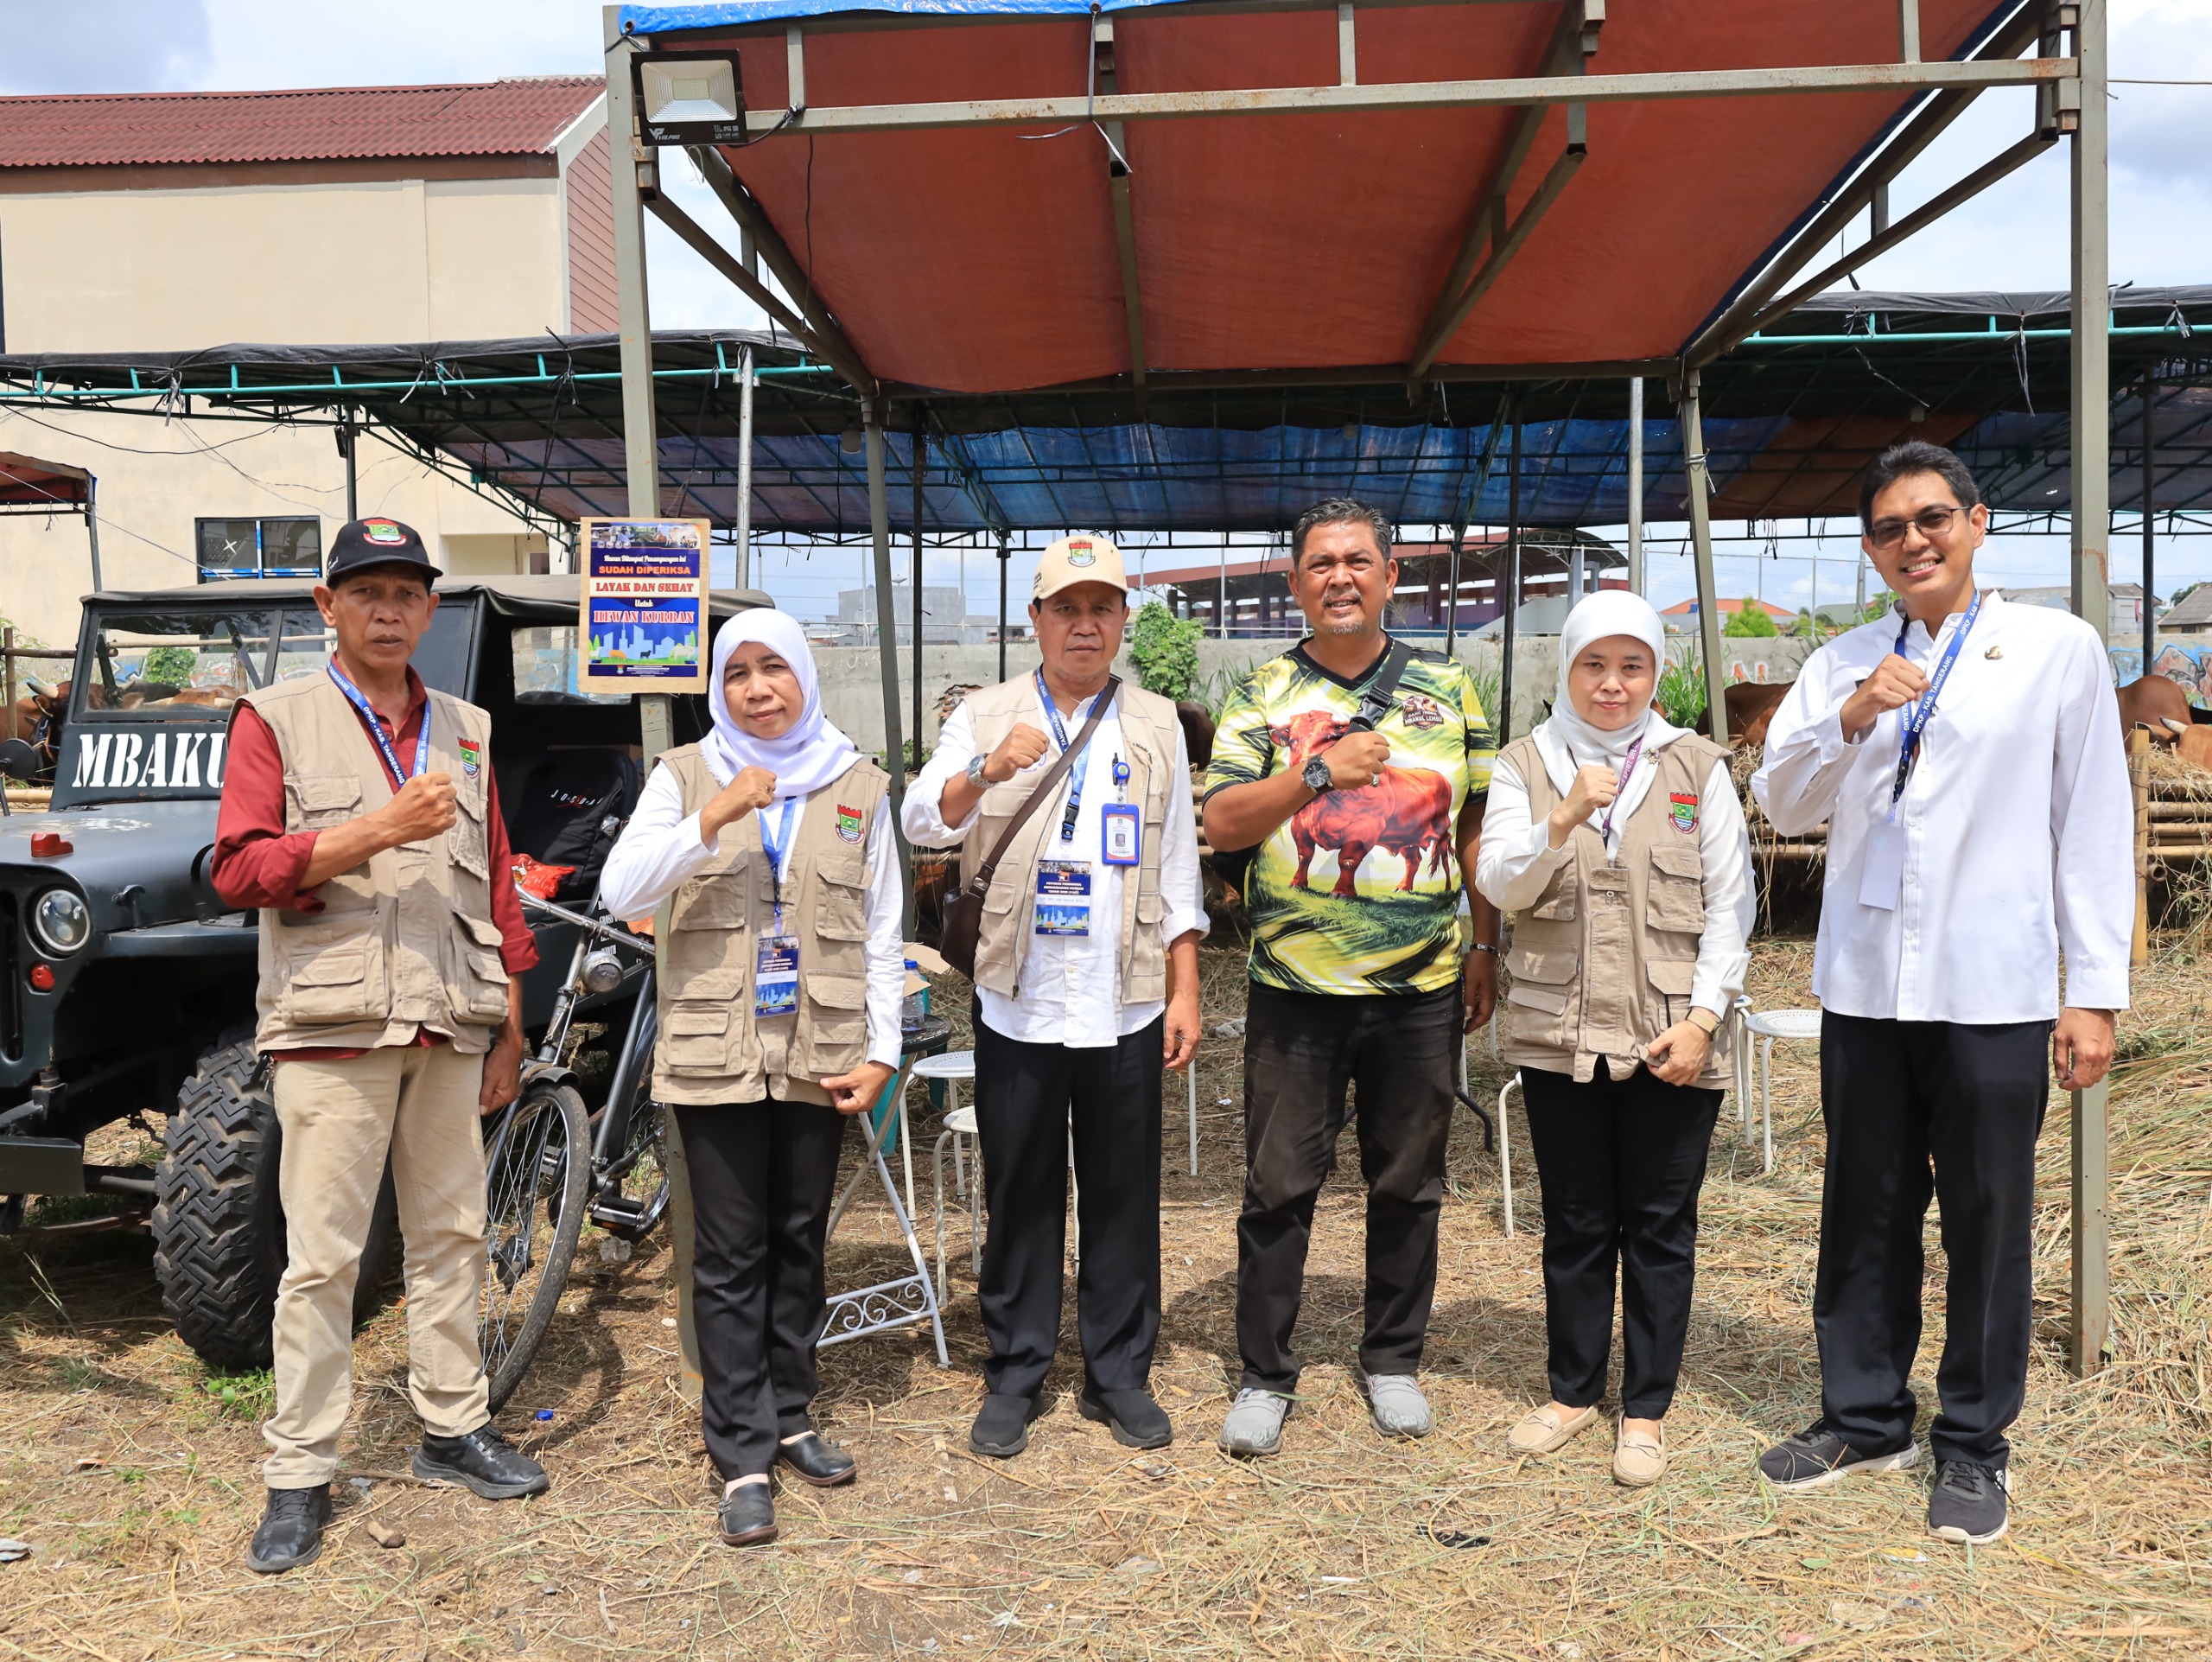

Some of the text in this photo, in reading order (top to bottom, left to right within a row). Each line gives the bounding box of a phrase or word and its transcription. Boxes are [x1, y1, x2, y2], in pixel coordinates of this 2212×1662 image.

[636, 566, 691, 575] DIPERIKSA
[596, 583, 631, 591] LAYAK
[658, 583, 694, 592] SEHAT
[594, 610, 695, 623] HEWAN KURBAN
[1960, 619, 1970, 635] DPKP
[1912, 714, 1924, 733] DPKP
[1922, 694, 1935, 710] KAB.
[1929, 655, 1953, 694] TANGERANG
[1051, 711, 1068, 747] TANGERANG
[363, 706, 377, 724] DPKP
[375, 728, 385, 745] KAB.
[383, 744, 405, 784] TANGERANG
[550, 789, 604, 806] JORDA
